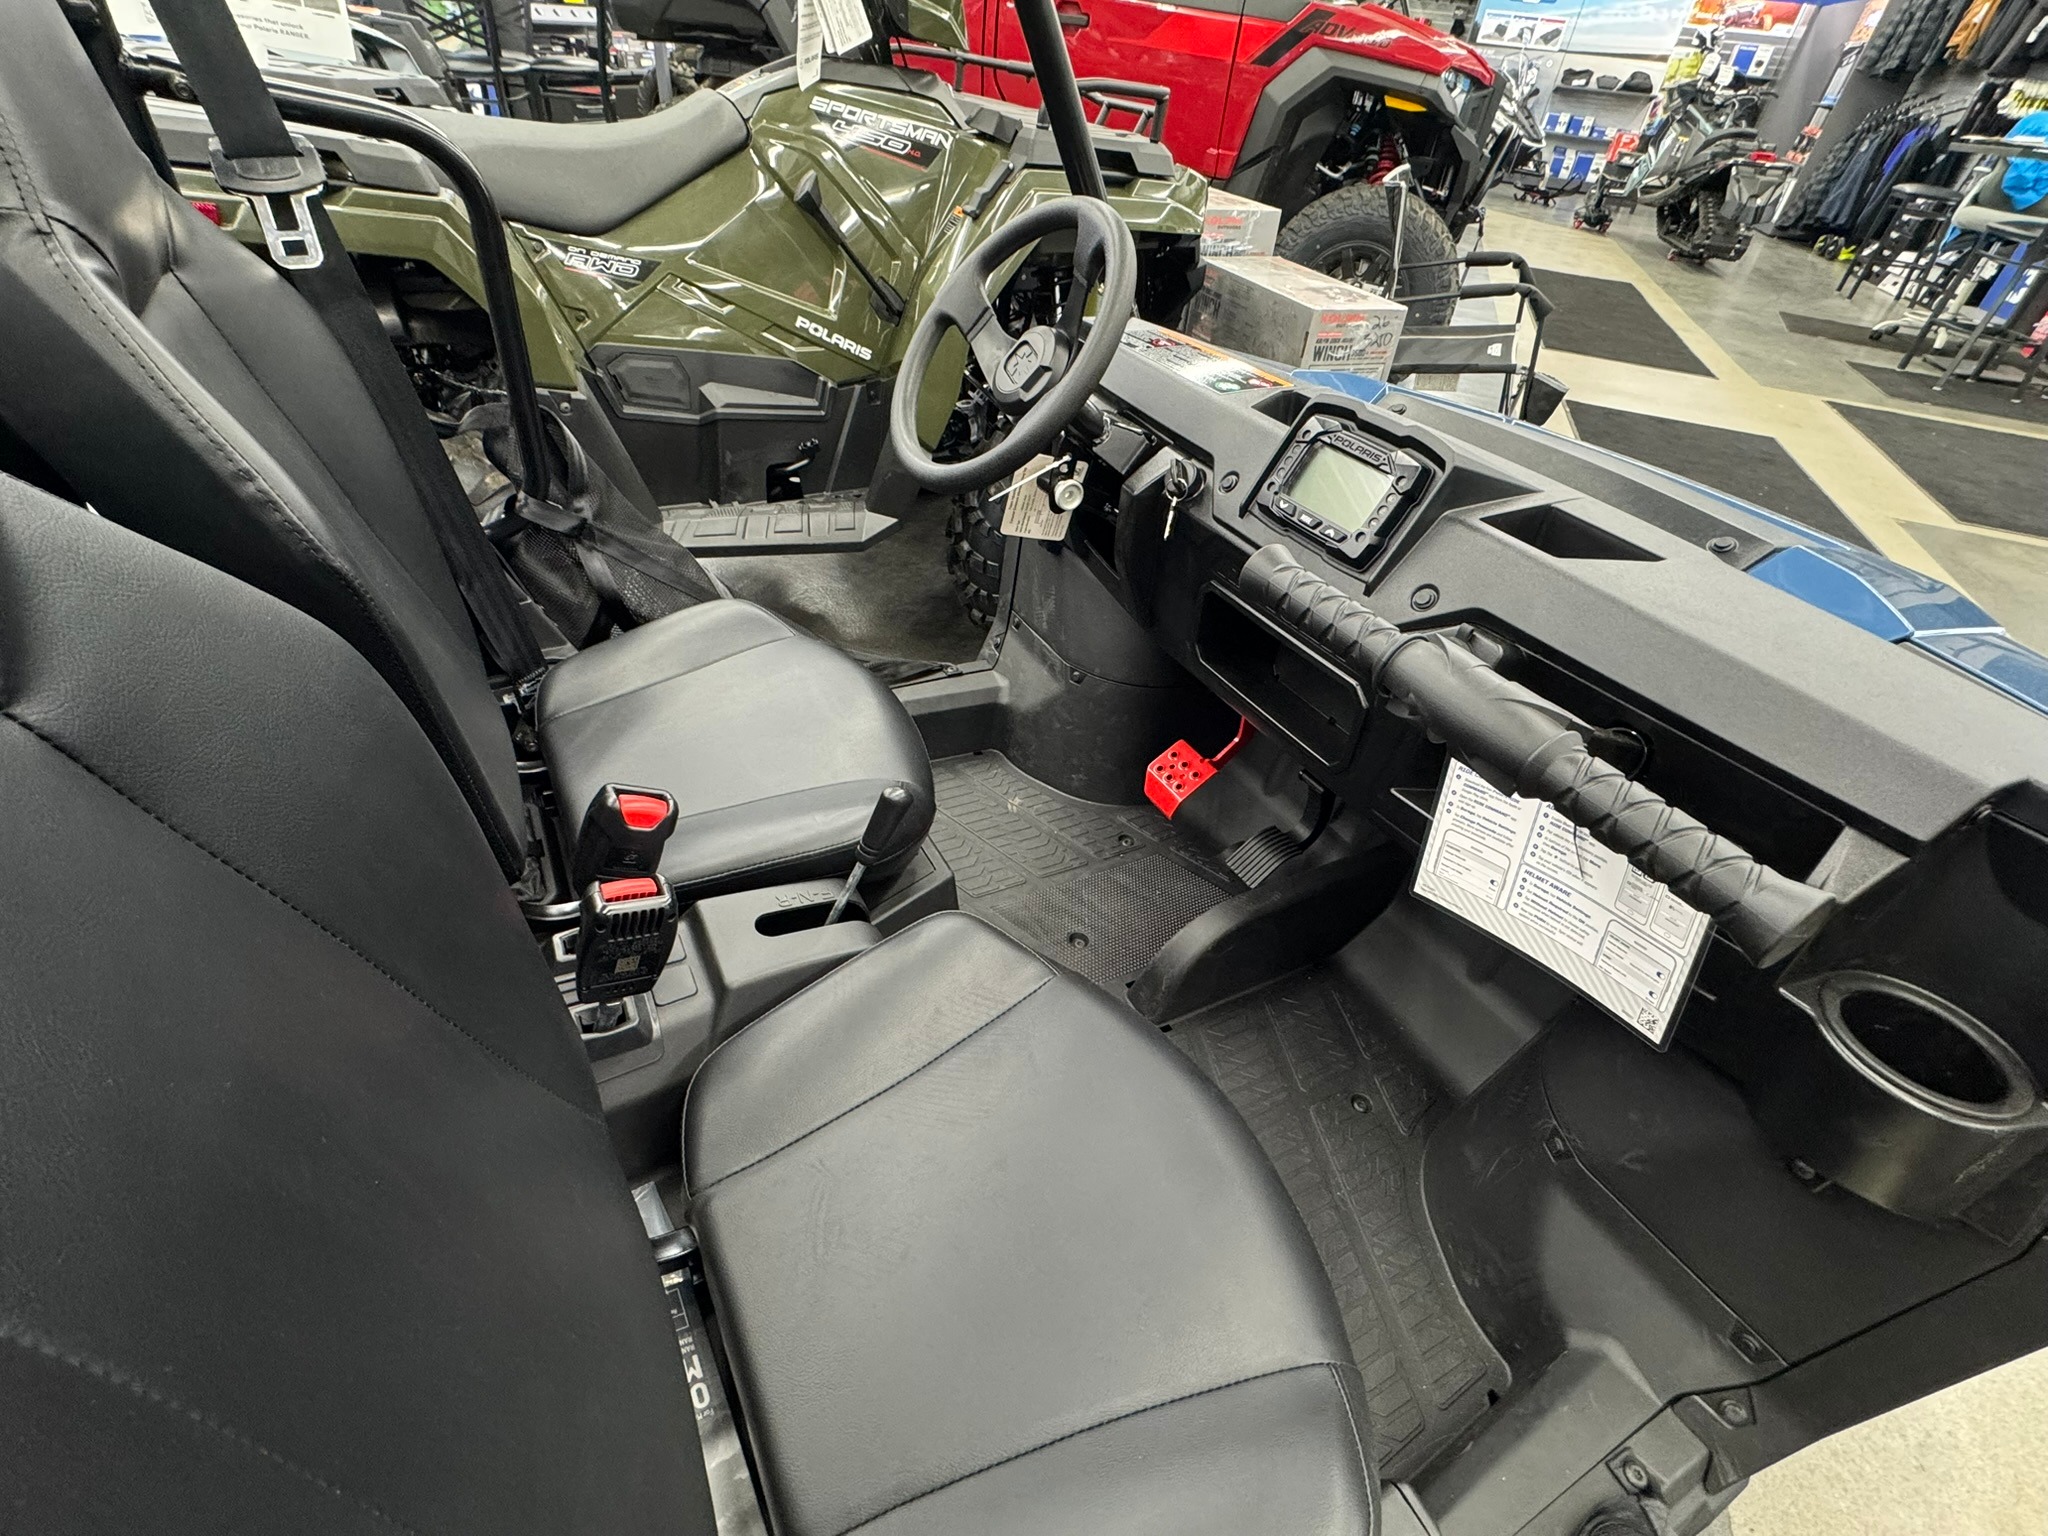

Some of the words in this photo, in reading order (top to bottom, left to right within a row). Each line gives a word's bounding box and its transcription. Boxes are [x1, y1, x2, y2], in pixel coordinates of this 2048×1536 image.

[810, 96, 953, 149] SPORTSMAN
[564, 252, 640, 277] AWD
[567, 246, 586, 254] ON
[590, 251, 641, 265] DEMAND
[795, 315, 872, 361] POLARIS
[1312, 344, 1353, 362] WINCH
[1334, 435, 1382, 462] POLARIS
[1523, 867, 1549, 885] HELMET
[1548, 881, 1572, 897] AWARE
